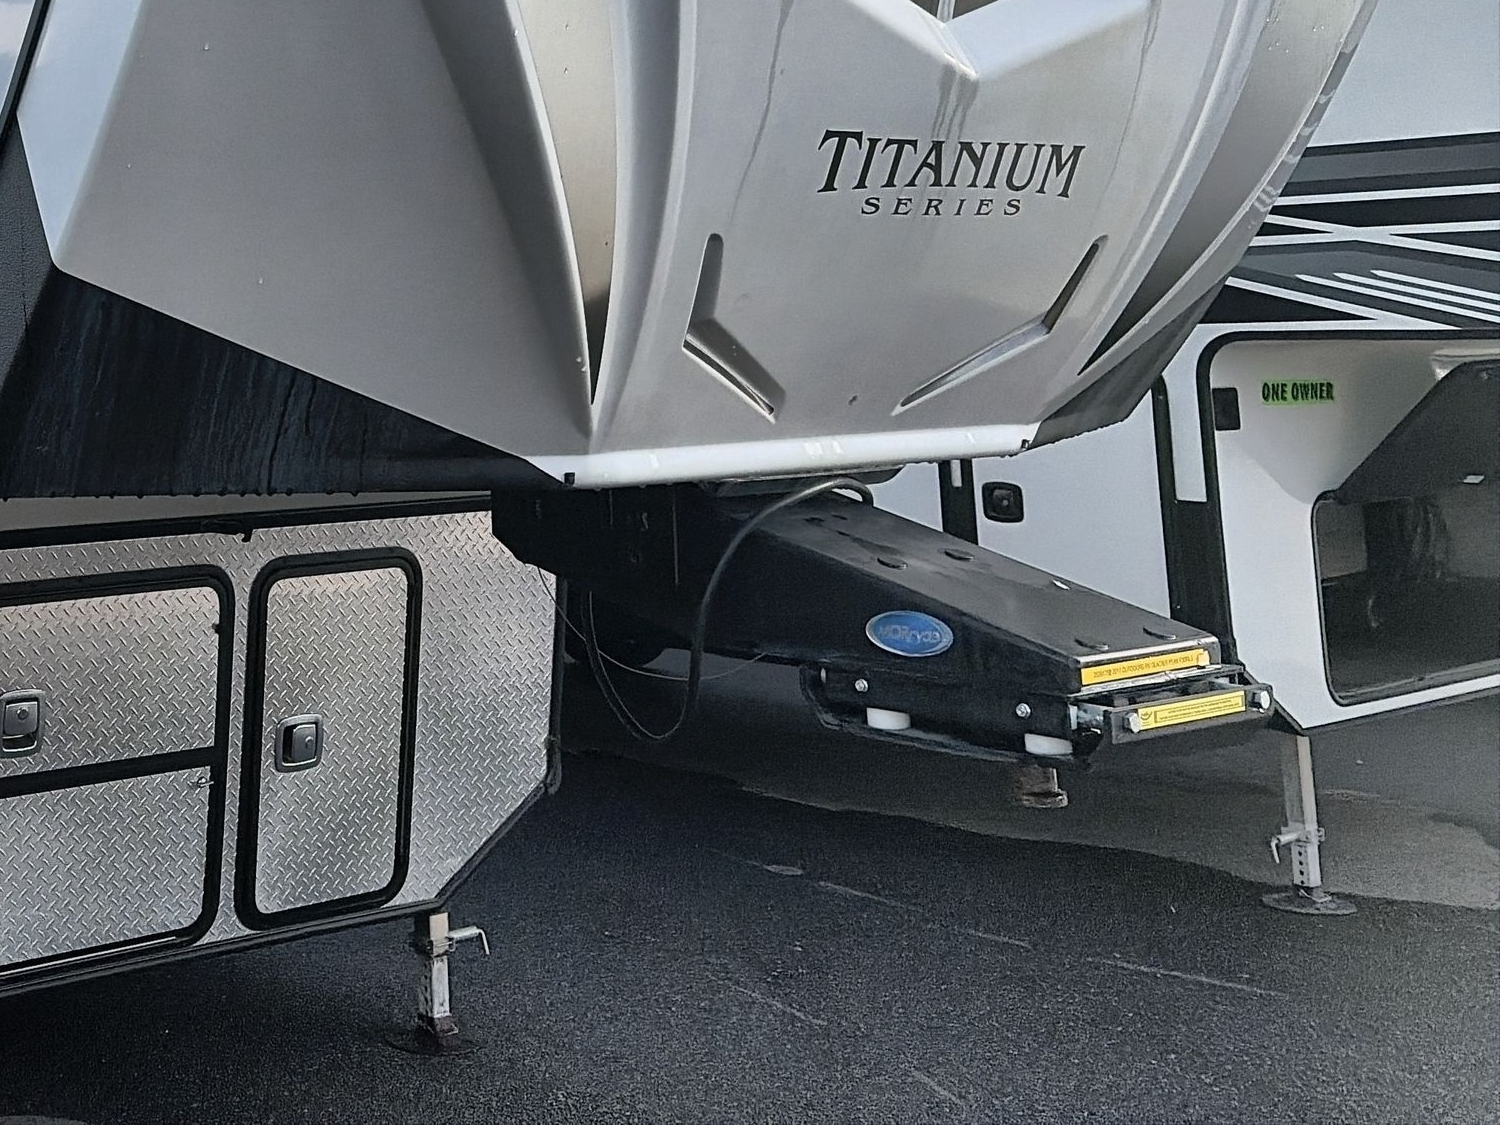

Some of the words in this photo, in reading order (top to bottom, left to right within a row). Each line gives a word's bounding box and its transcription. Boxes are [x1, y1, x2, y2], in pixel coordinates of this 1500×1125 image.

[817, 129, 1086, 199] TITANIUM
[861, 196, 1021, 216] SERIES
[1261, 382, 1288, 402] ONE
[1291, 381, 1335, 401] OWNER
